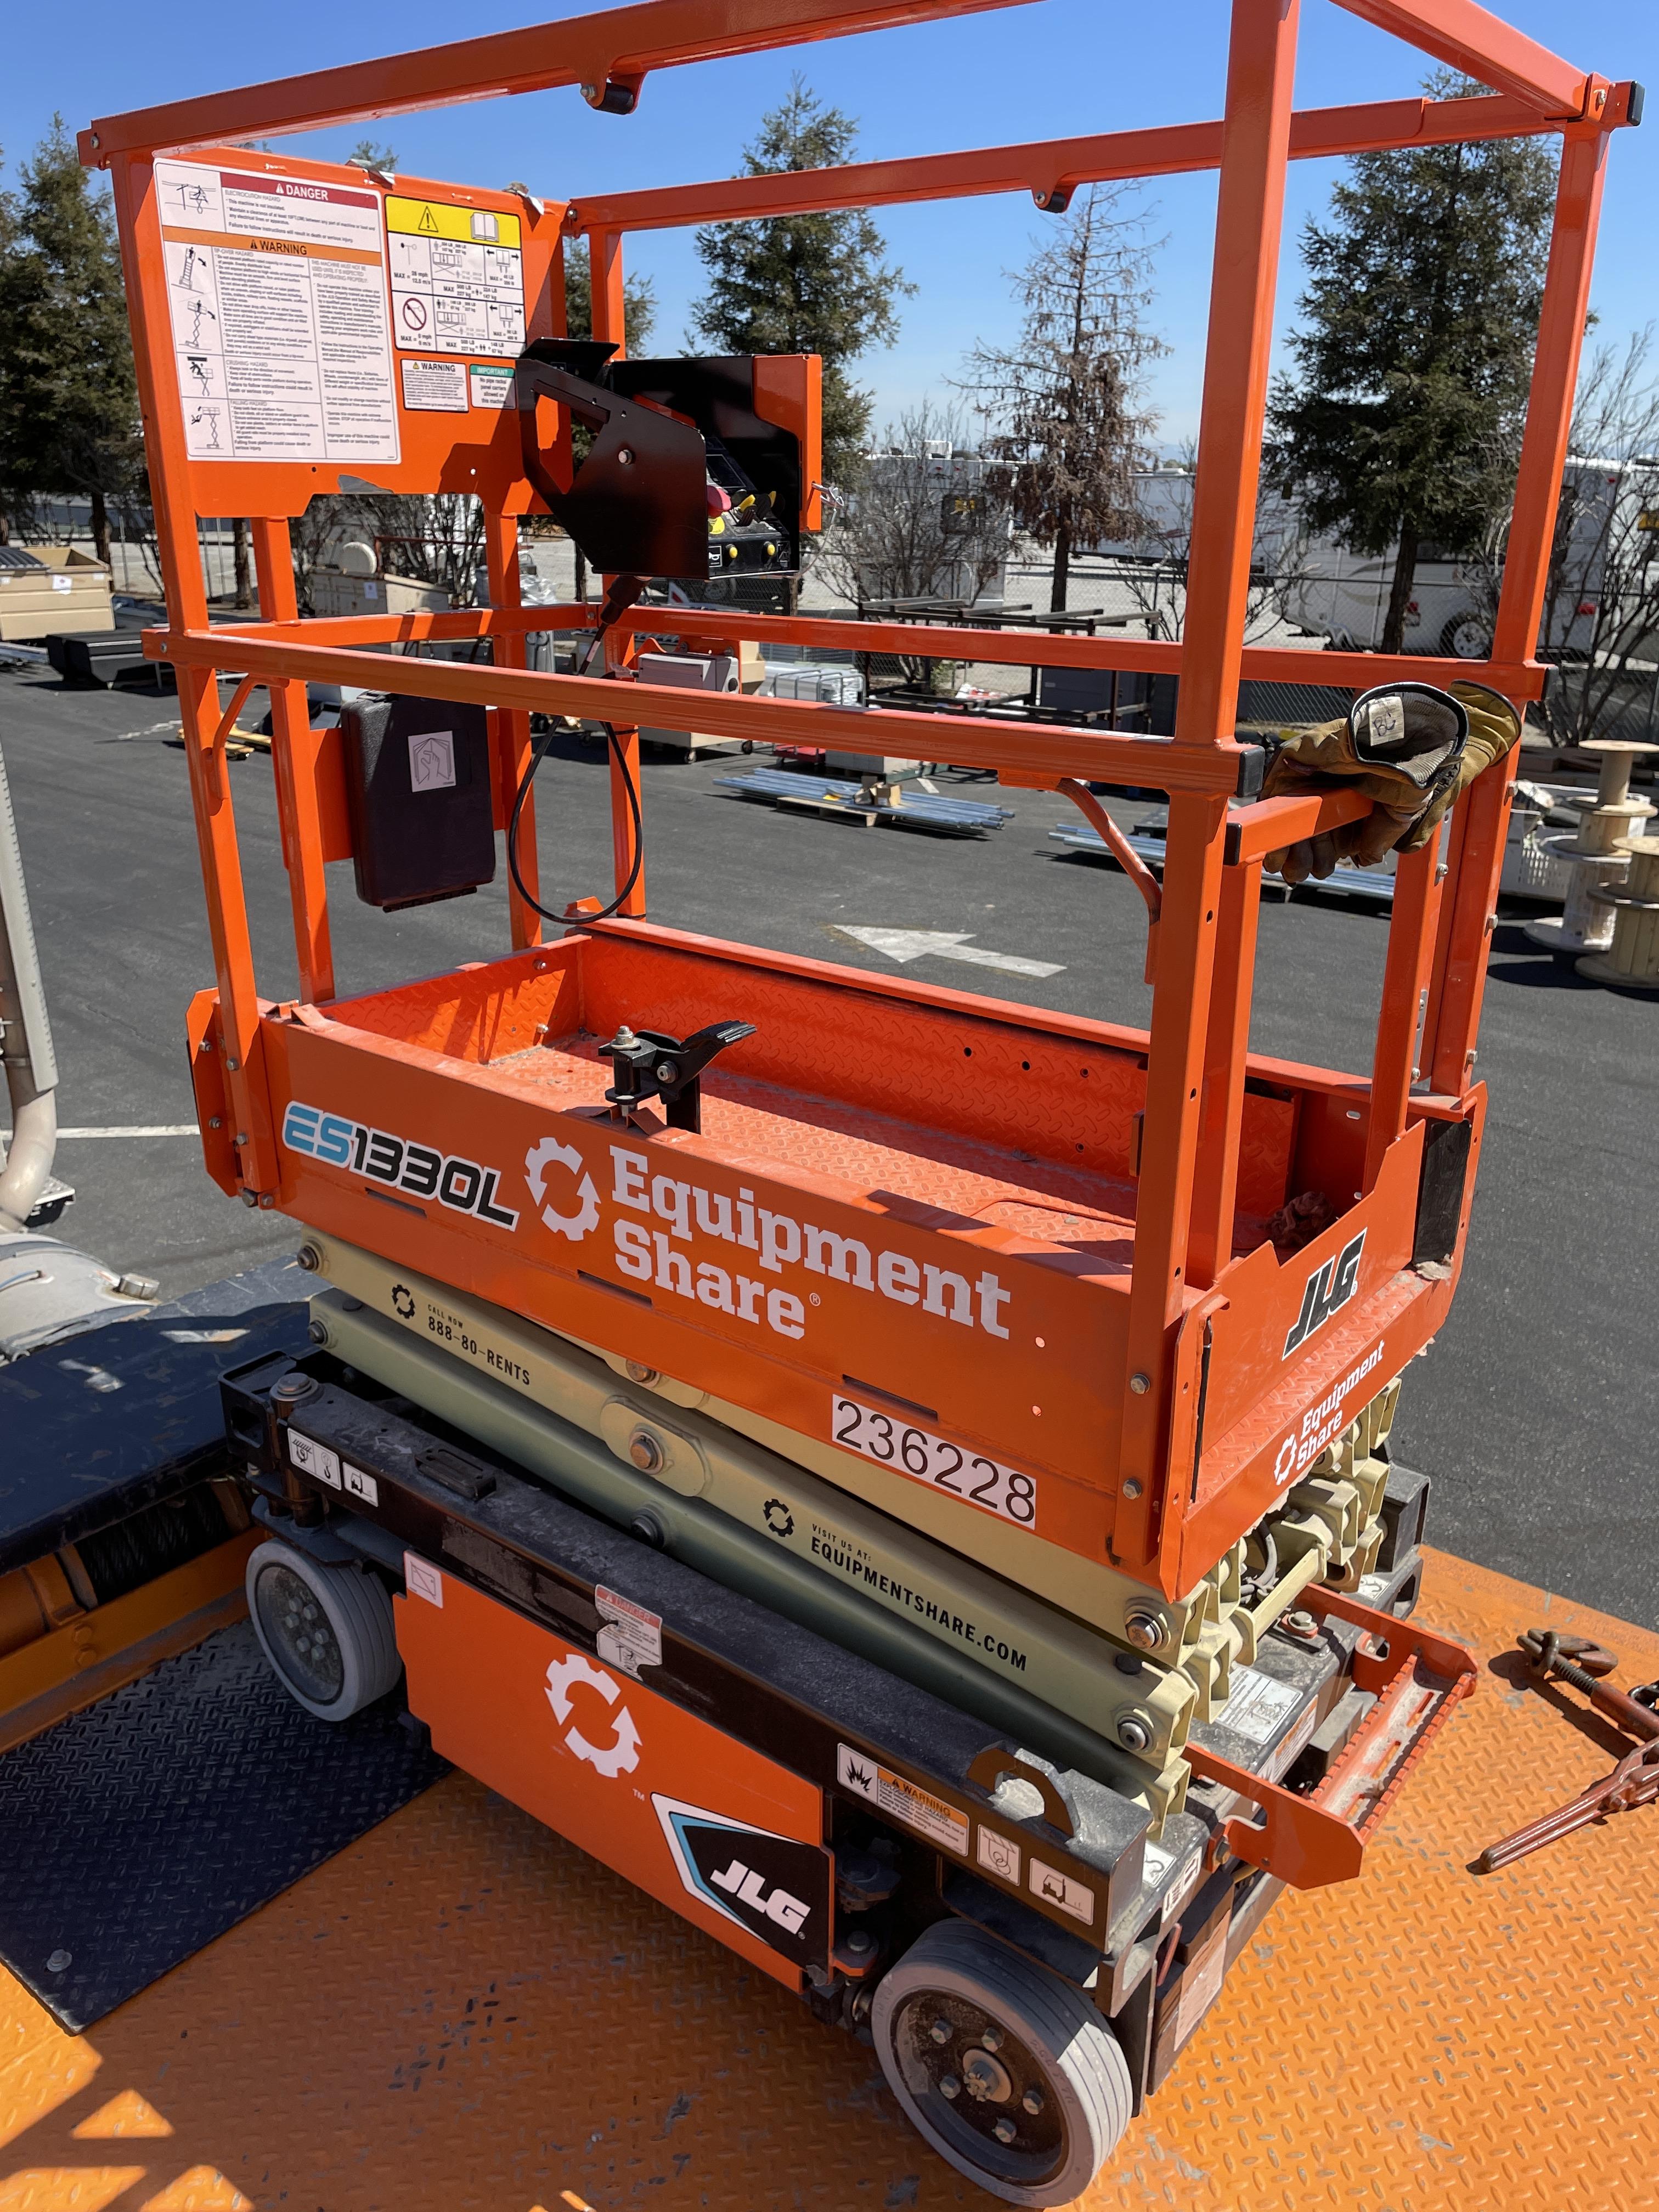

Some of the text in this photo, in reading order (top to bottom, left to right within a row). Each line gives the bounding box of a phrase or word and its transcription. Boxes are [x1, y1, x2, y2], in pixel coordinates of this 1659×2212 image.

[286, 184, 328, 201] DANGER
[259, 240, 307, 255] WARNING
[421, 363, 455, 372] WARNING
[477, 367, 508, 375] IMPORTANT
[282, 1101, 519, 1232] ES1330L
[609, 1145, 1011, 1339] Equipment
[428, 1304, 463, 1329] CALL NOW
[1282, 1227, 1367, 1361] JLG
[429, 1316, 530, 1385] 888-80-RENTS
[1300, 1340, 1384, 1440] Equipment
[836, 1401, 1034, 1522] 236228
[1297, 1410, 1343, 1471] Share
[812, 1524, 871, 1562] VISIT US AT:
[615, 1598, 650, 1622] DANGER
[811, 1536, 1027, 1671] EQUIPMENTSHARE.COM
[632, 1788, 645, 1801] TM
[903, 1785, 950, 1816] WARNING
[710, 1860, 811, 1934] JLG
